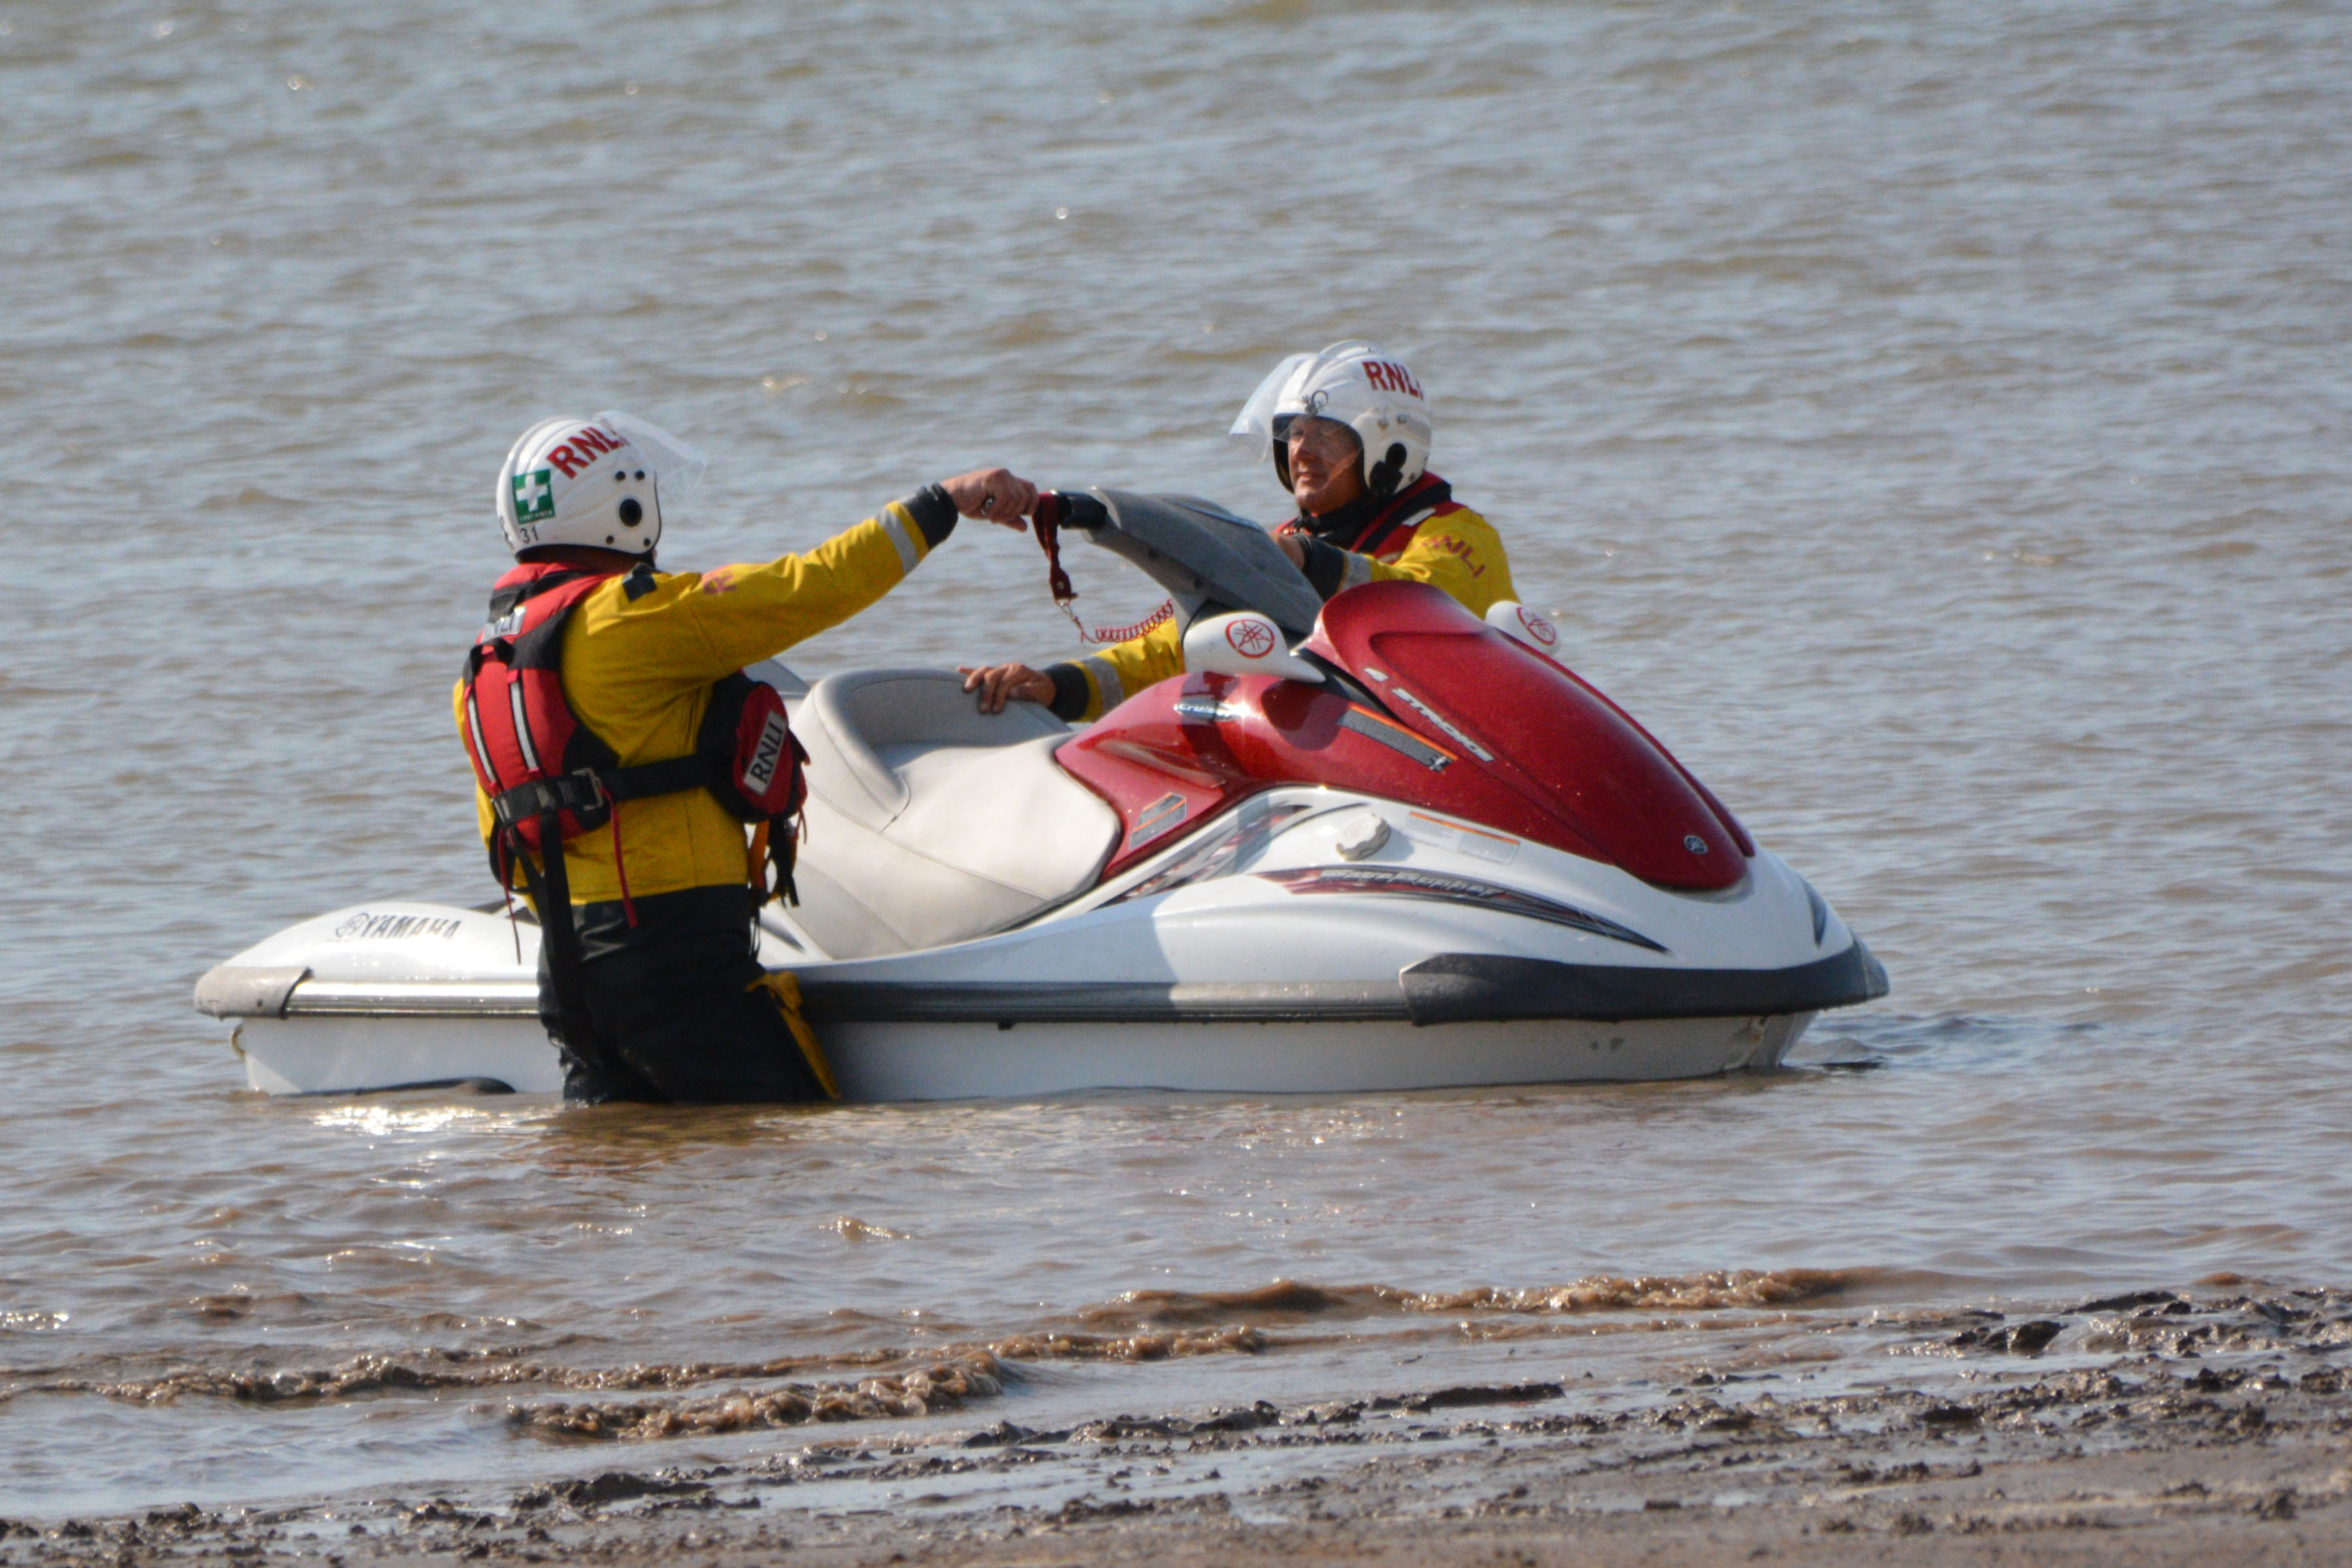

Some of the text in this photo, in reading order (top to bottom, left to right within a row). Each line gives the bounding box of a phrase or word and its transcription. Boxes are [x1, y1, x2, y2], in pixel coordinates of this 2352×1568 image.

[520, 525, 538, 544] 31
[1364, 667, 1389, 682] 4
[1391, 687, 1495, 762] STROKE
[750, 721, 784, 784] RNLI
[361, 915, 462, 941] YAMAHA
